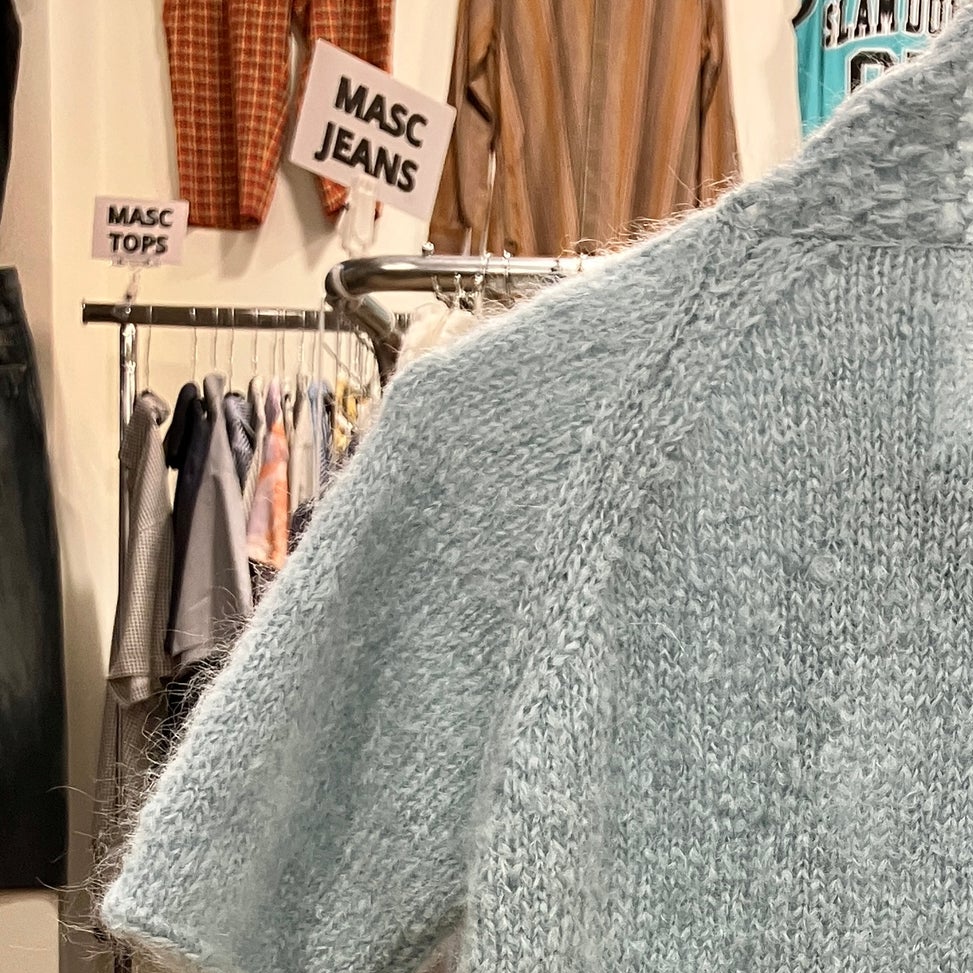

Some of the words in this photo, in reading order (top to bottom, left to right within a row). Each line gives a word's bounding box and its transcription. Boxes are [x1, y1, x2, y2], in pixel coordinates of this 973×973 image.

[335, 75, 428, 148] MASC
[314, 121, 419, 193] JEANS
[107, 205, 174, 228] MASC
[108, 232, 168, 254] TOPS
